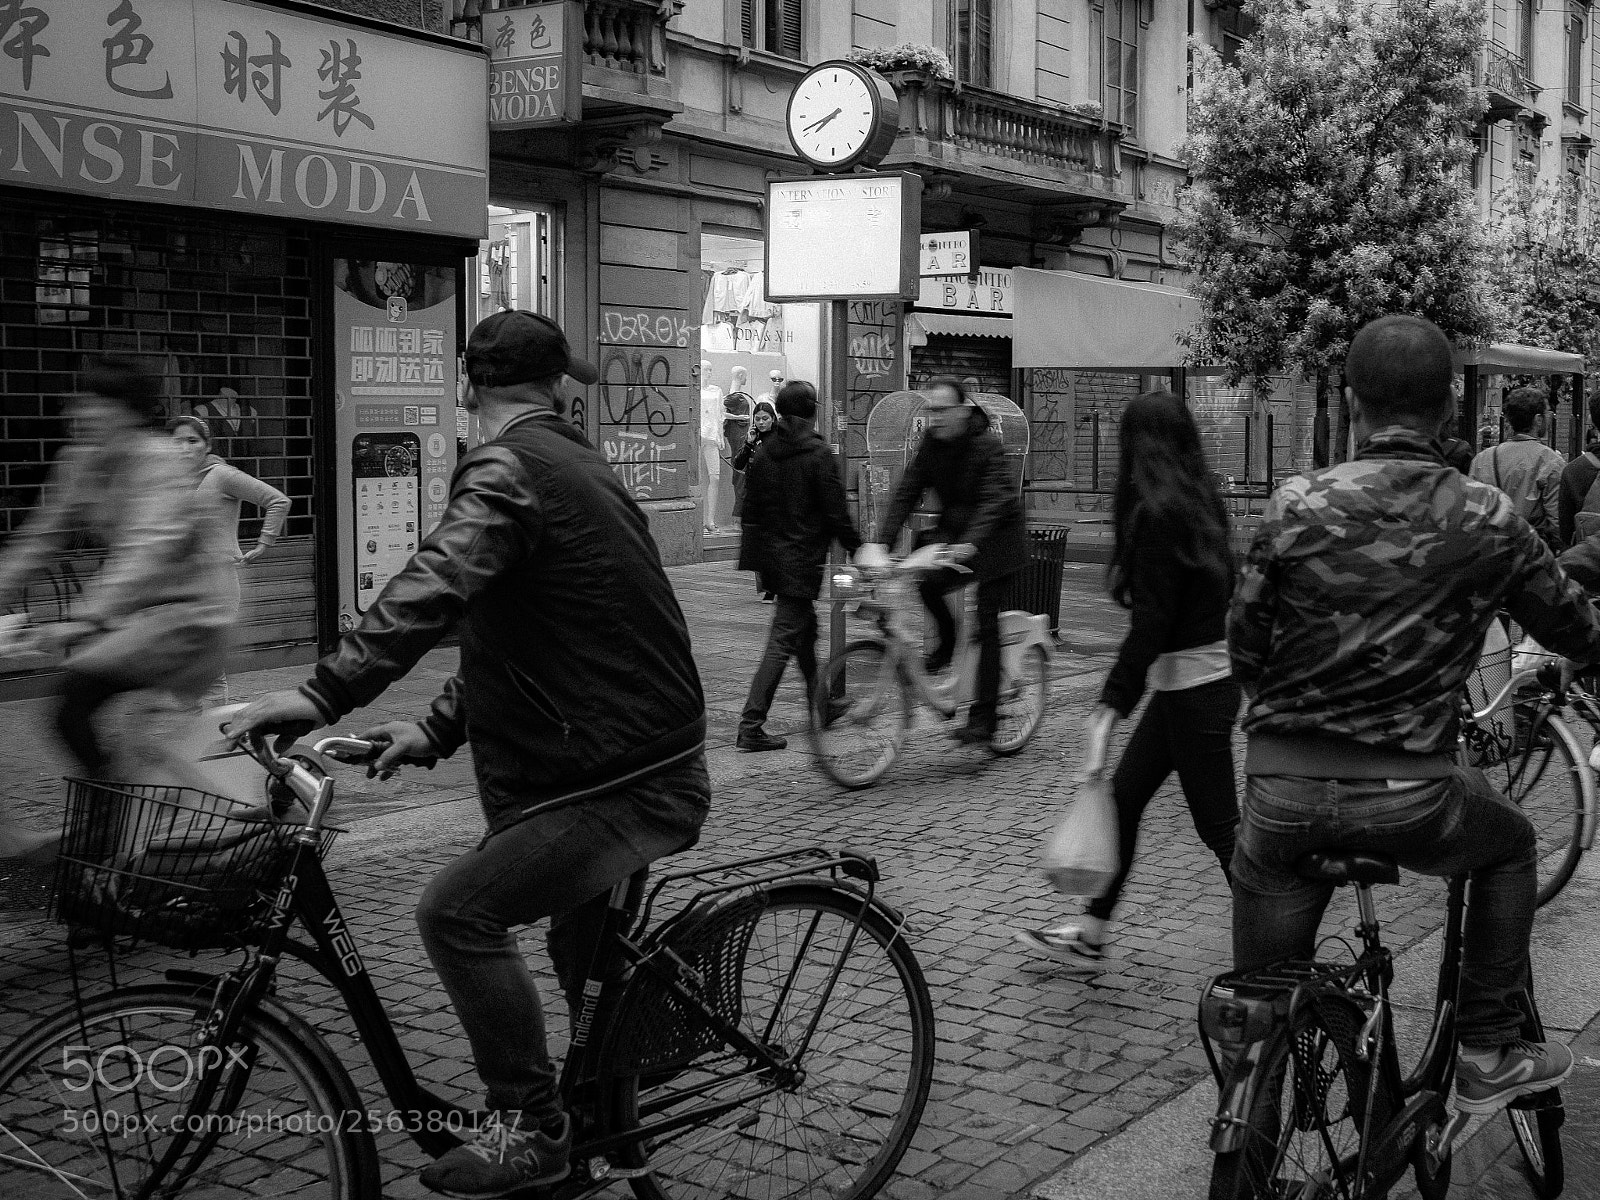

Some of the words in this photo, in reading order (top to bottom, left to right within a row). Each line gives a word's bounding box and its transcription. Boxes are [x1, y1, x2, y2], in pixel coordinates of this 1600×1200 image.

[490, 92, 557, 121] MODA
[0, 110, 182, 191] NSE
[232, 145, 432, 222] MODA
[776, 187, 857, 201] INTERNATIONA
[862, 185, 897, 198] STORE
[942, 283, 1004, 311] BAR
[350, 356, 445, 384] 即刻送达
[322, 907, 363, 977] WEG
[570, 994, 599, 1047] holland
